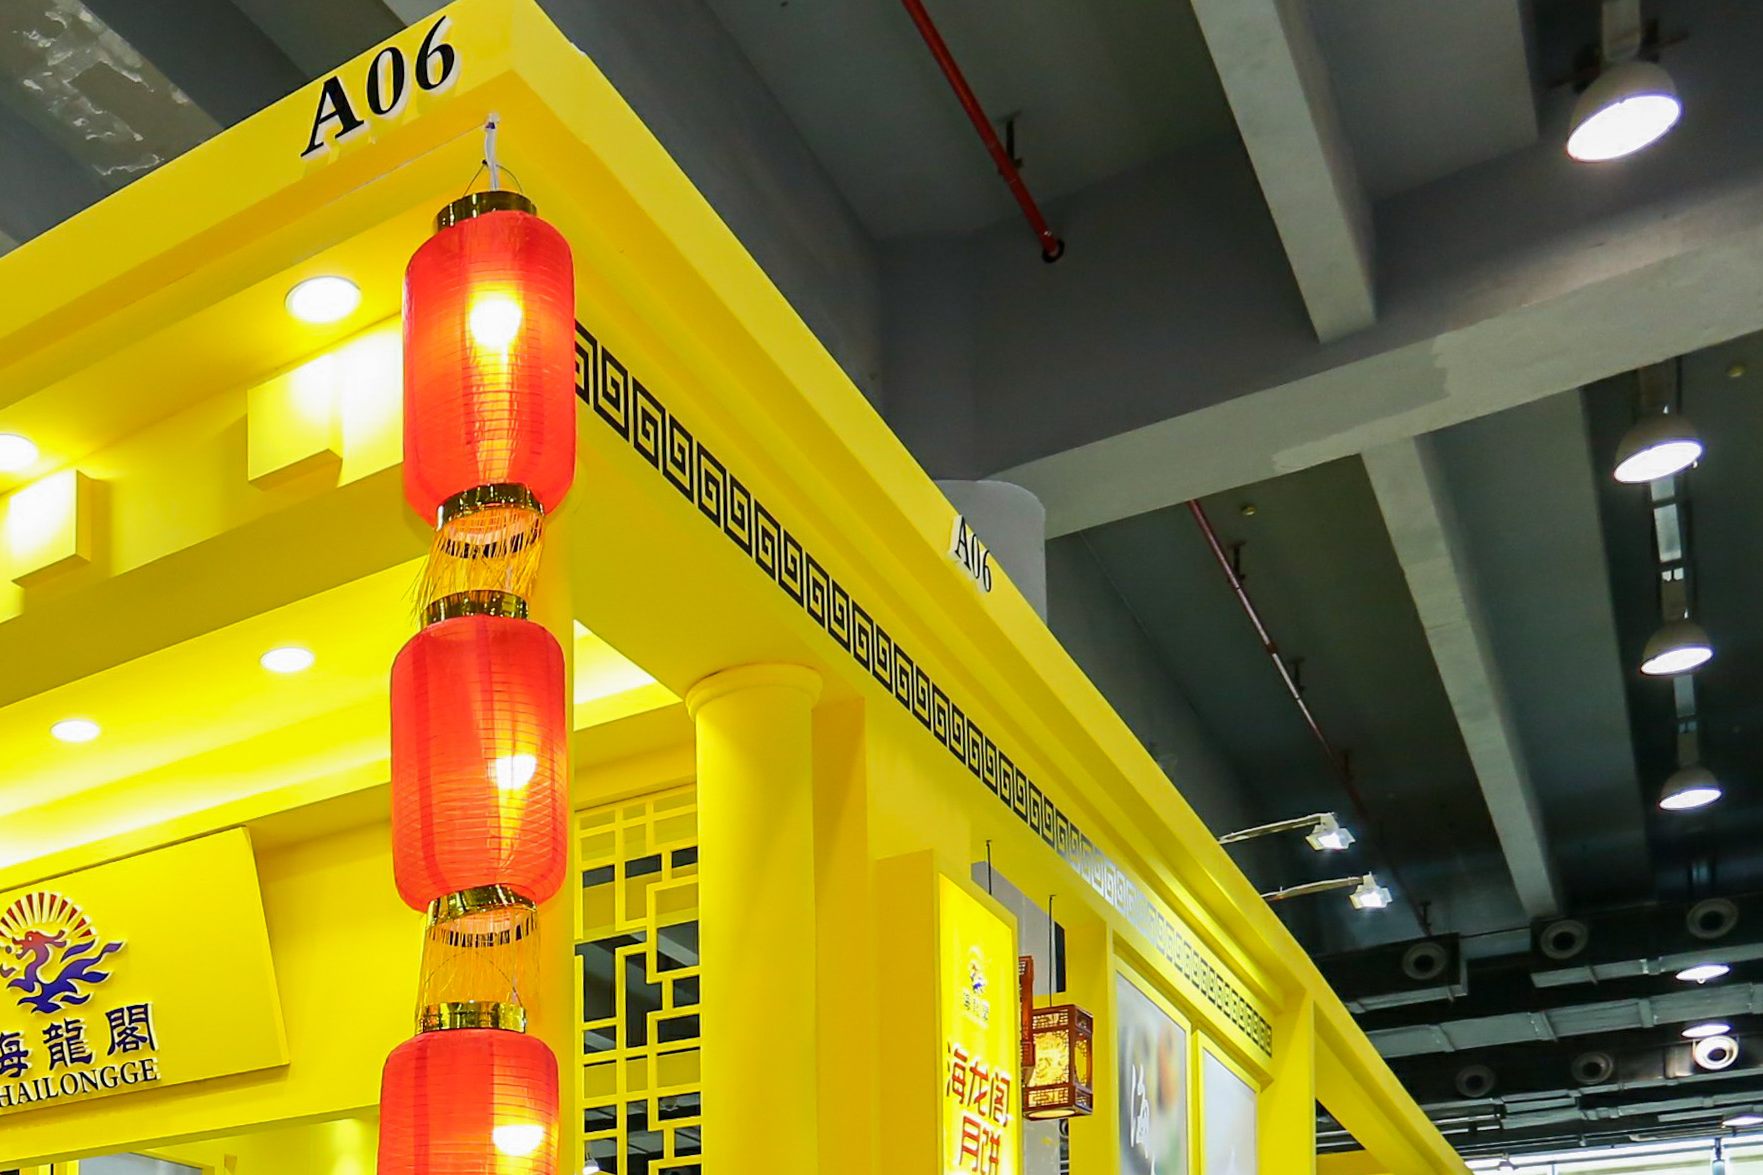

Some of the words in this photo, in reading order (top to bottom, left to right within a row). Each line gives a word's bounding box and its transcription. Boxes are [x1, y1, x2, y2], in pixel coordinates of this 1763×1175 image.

[300, 15, 455, 158] A06
[954, 516, 992, 593] A06
[946, 1042, 1010, 1128] 海龙阁
